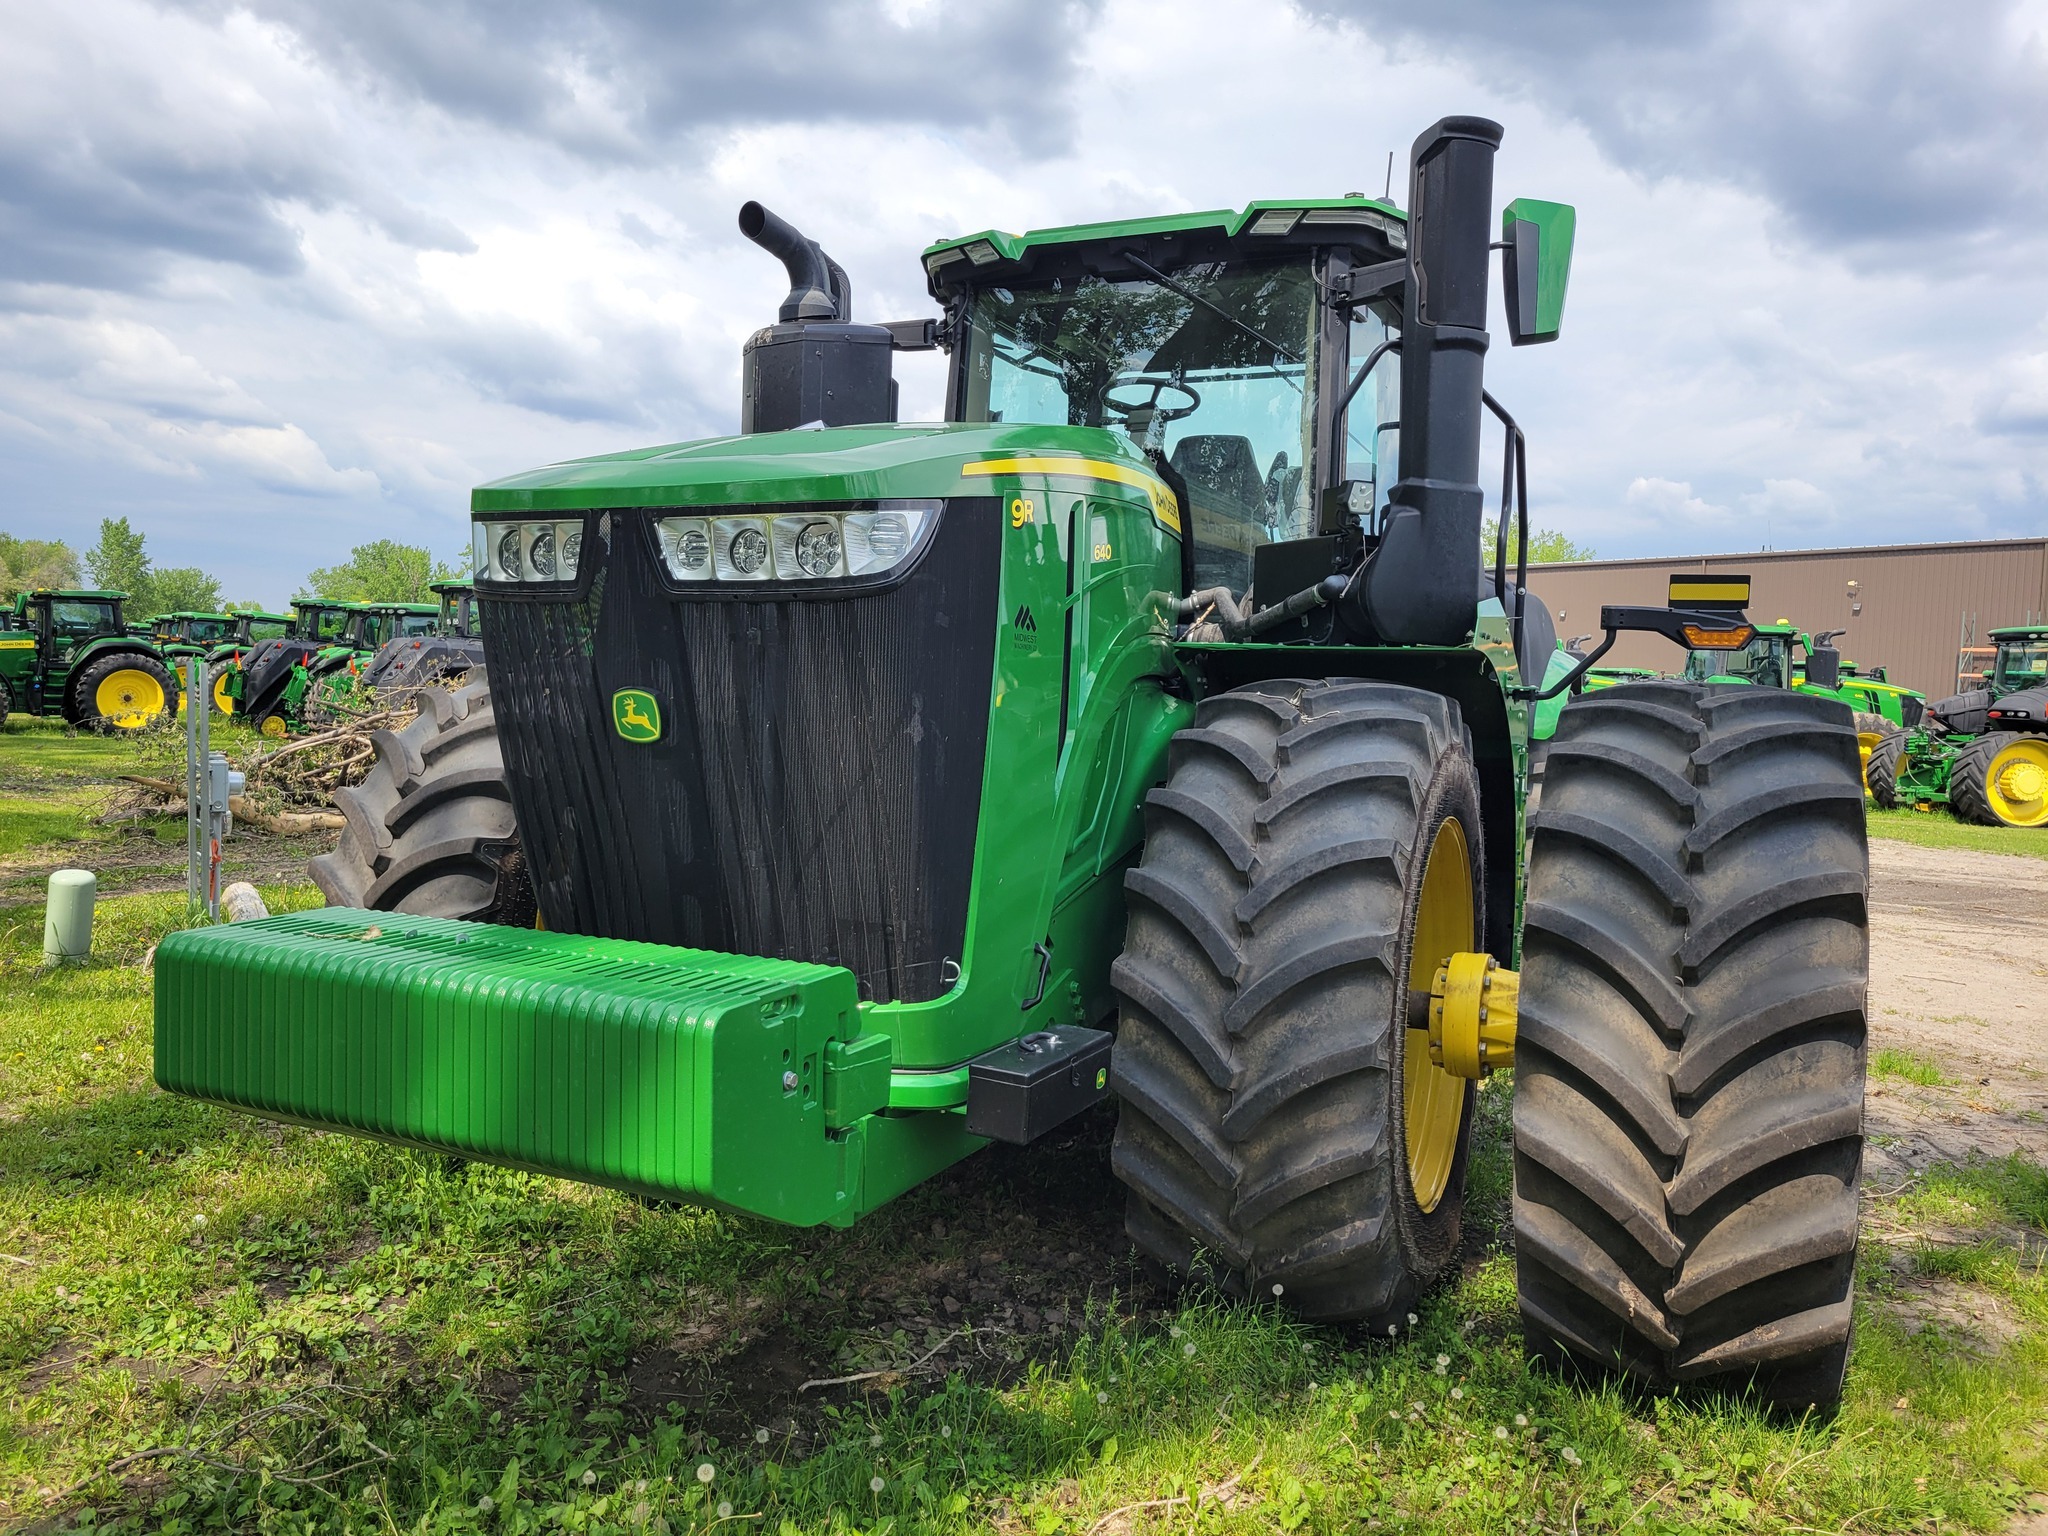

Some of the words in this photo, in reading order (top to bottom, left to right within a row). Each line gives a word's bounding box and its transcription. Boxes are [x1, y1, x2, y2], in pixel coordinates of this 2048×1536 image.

[1011, 499, 1034, 529] 9R
[1094, 544, 1112, 560] 640
[1014, 633, 1037, 644] MIDWEST
